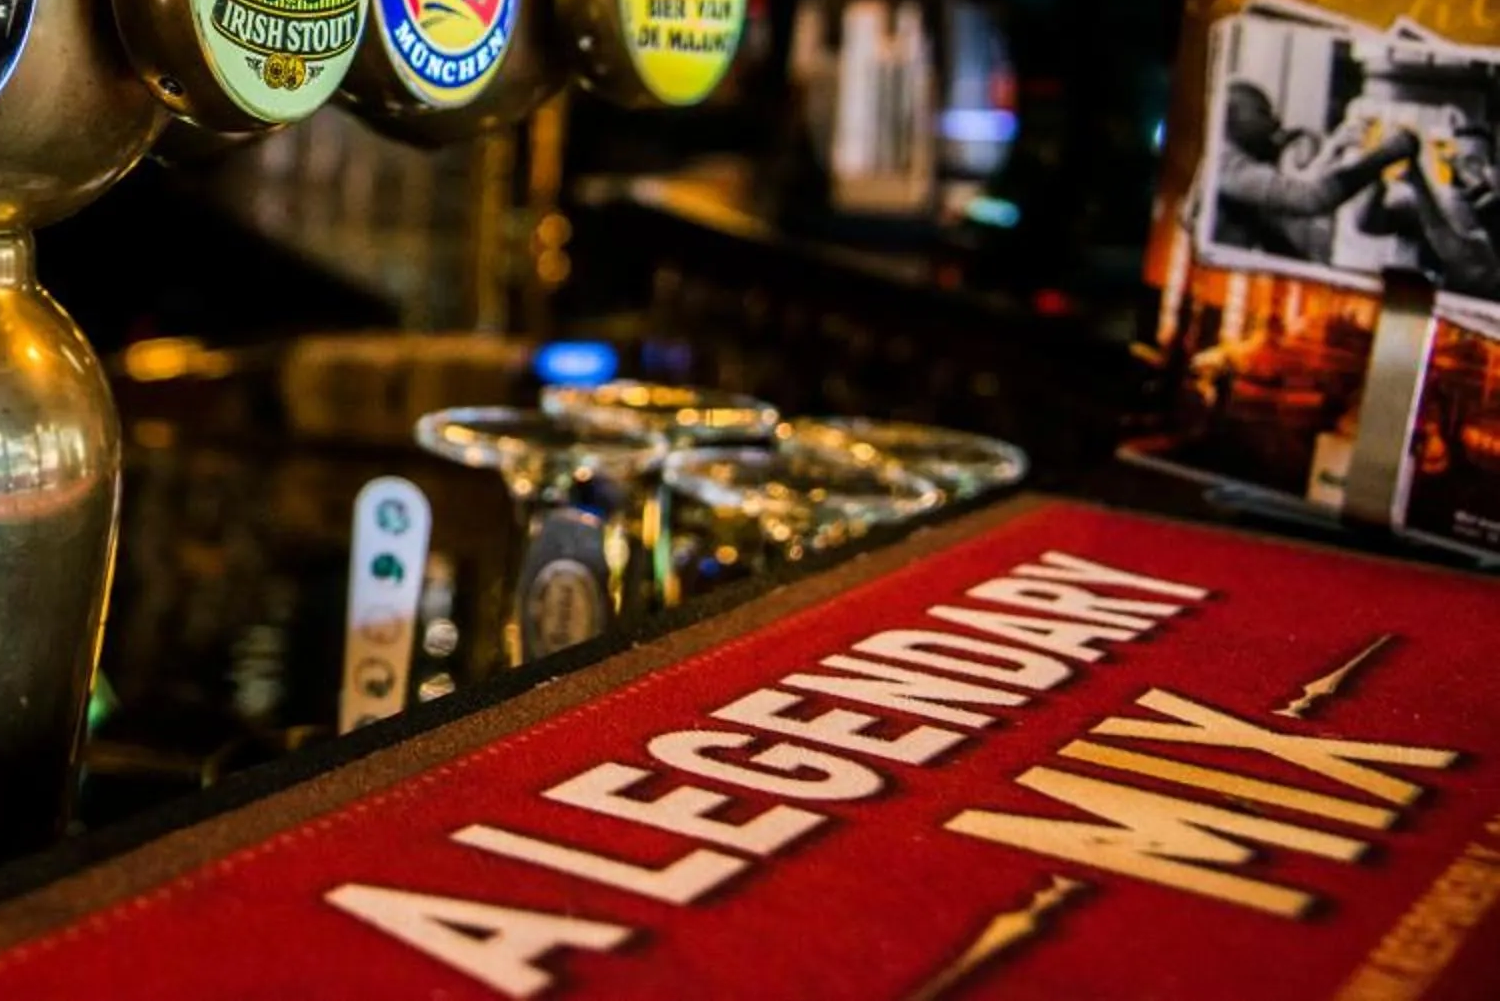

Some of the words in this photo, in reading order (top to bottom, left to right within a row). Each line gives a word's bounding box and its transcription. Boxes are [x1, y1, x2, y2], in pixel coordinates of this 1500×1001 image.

[221, 1, 288, 48] IRISH
[288, 13, 355, 53] STOUT
[450, 550, 1210, 905] LEGENDARY
[943, 687, 1460, 918] MIX
[323, 883, 637, 999] A
